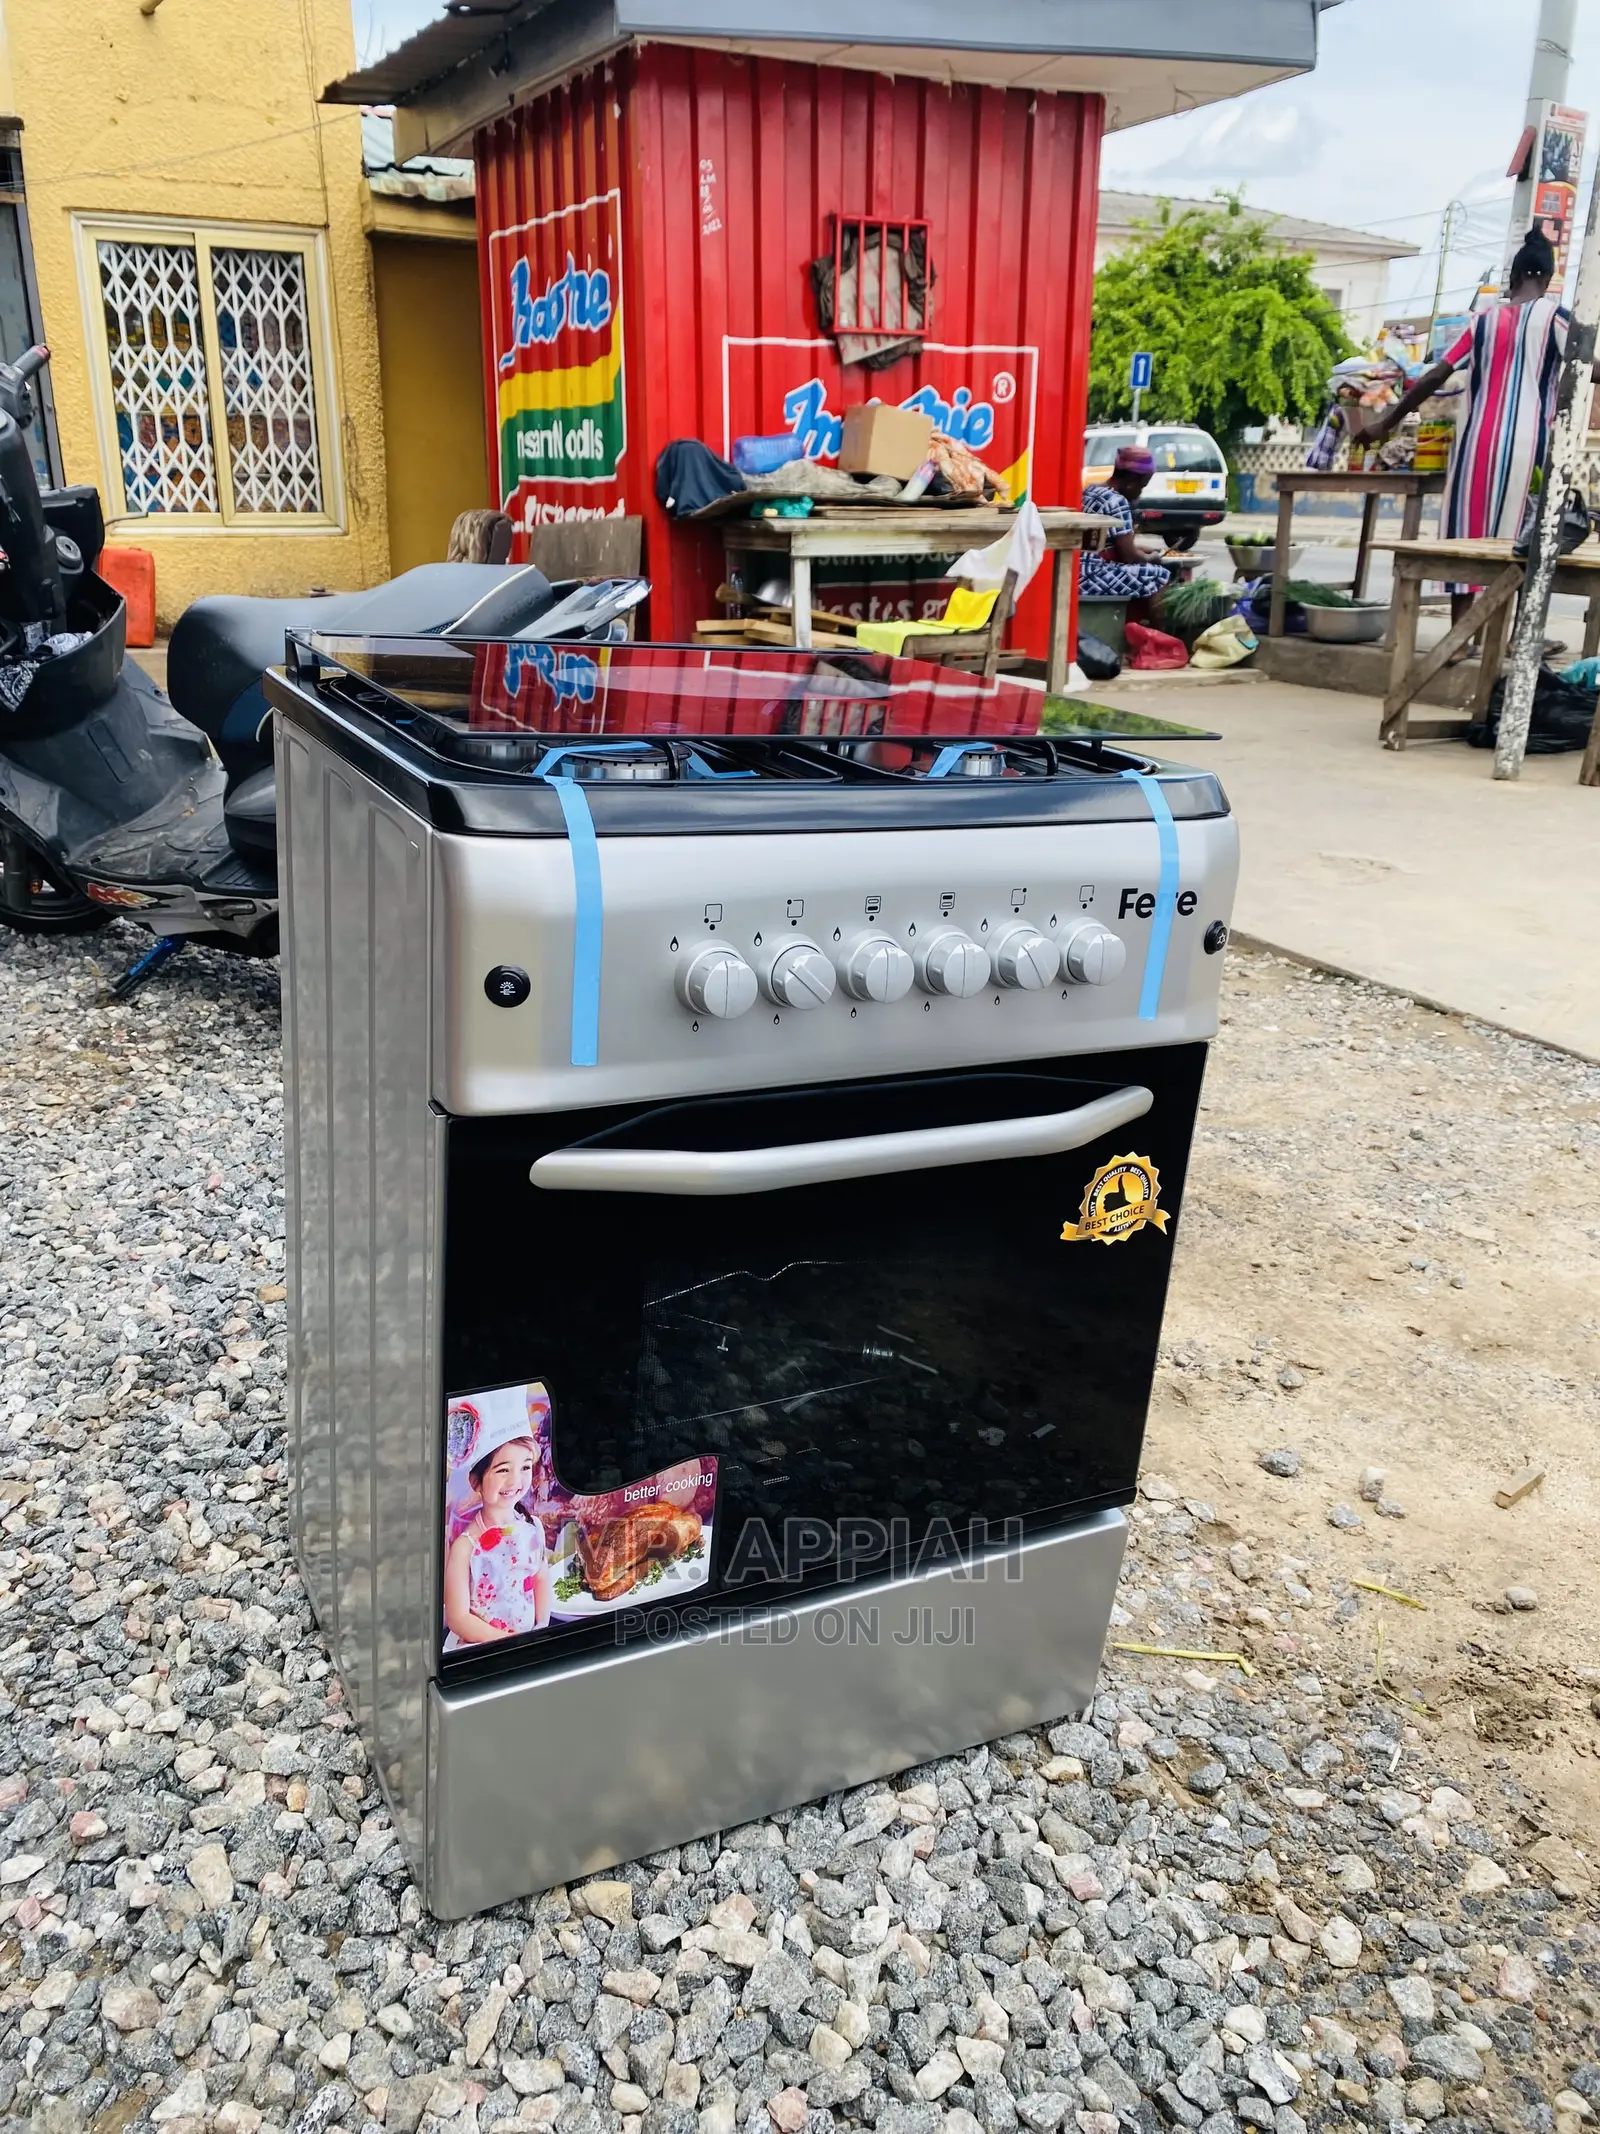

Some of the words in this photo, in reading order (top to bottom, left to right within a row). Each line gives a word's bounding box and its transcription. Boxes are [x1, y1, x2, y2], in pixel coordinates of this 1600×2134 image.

[1118, 888, 1197, 919] Fee
[1084, 1217, 1108, 1231] BEST
[1109, 1204, 1145, 1223] CHOICE
[623, 1483, 661, 1503] better
[665, 1472, 714, 1494] cooking
